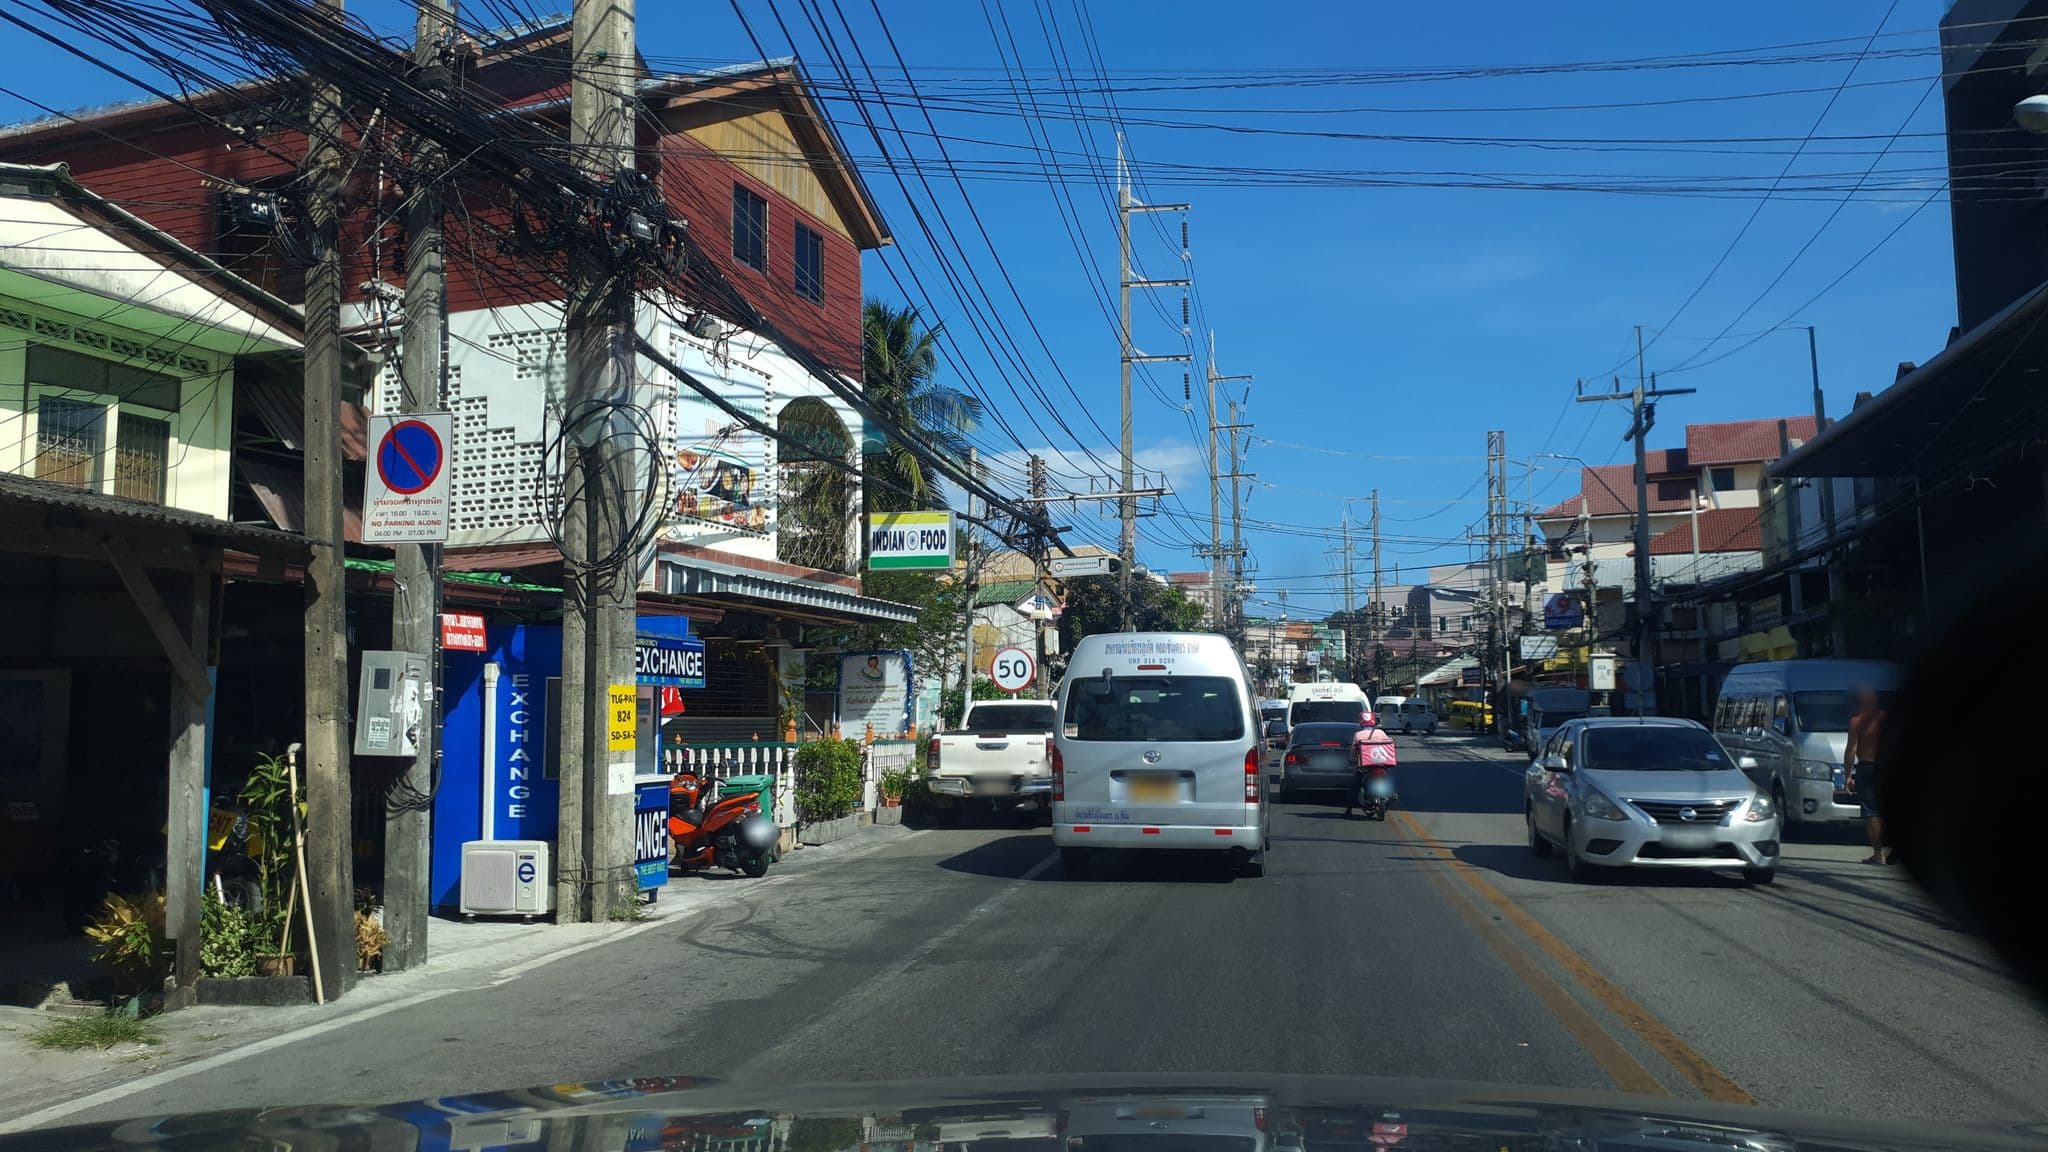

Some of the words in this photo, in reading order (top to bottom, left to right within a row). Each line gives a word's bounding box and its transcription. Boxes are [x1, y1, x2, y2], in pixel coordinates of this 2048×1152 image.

[873, 530, 905, 551] INDIAN
[920, 529, 946, 550] FOOD
[636, 647, 702, 676] EXCHANGE
[999, 660, 1026, 678] 50
[617, 710, 631, 722] 824
[508, 674, 530, 818] EXCHANGE
[635, 811, 666, 860] ANGE
